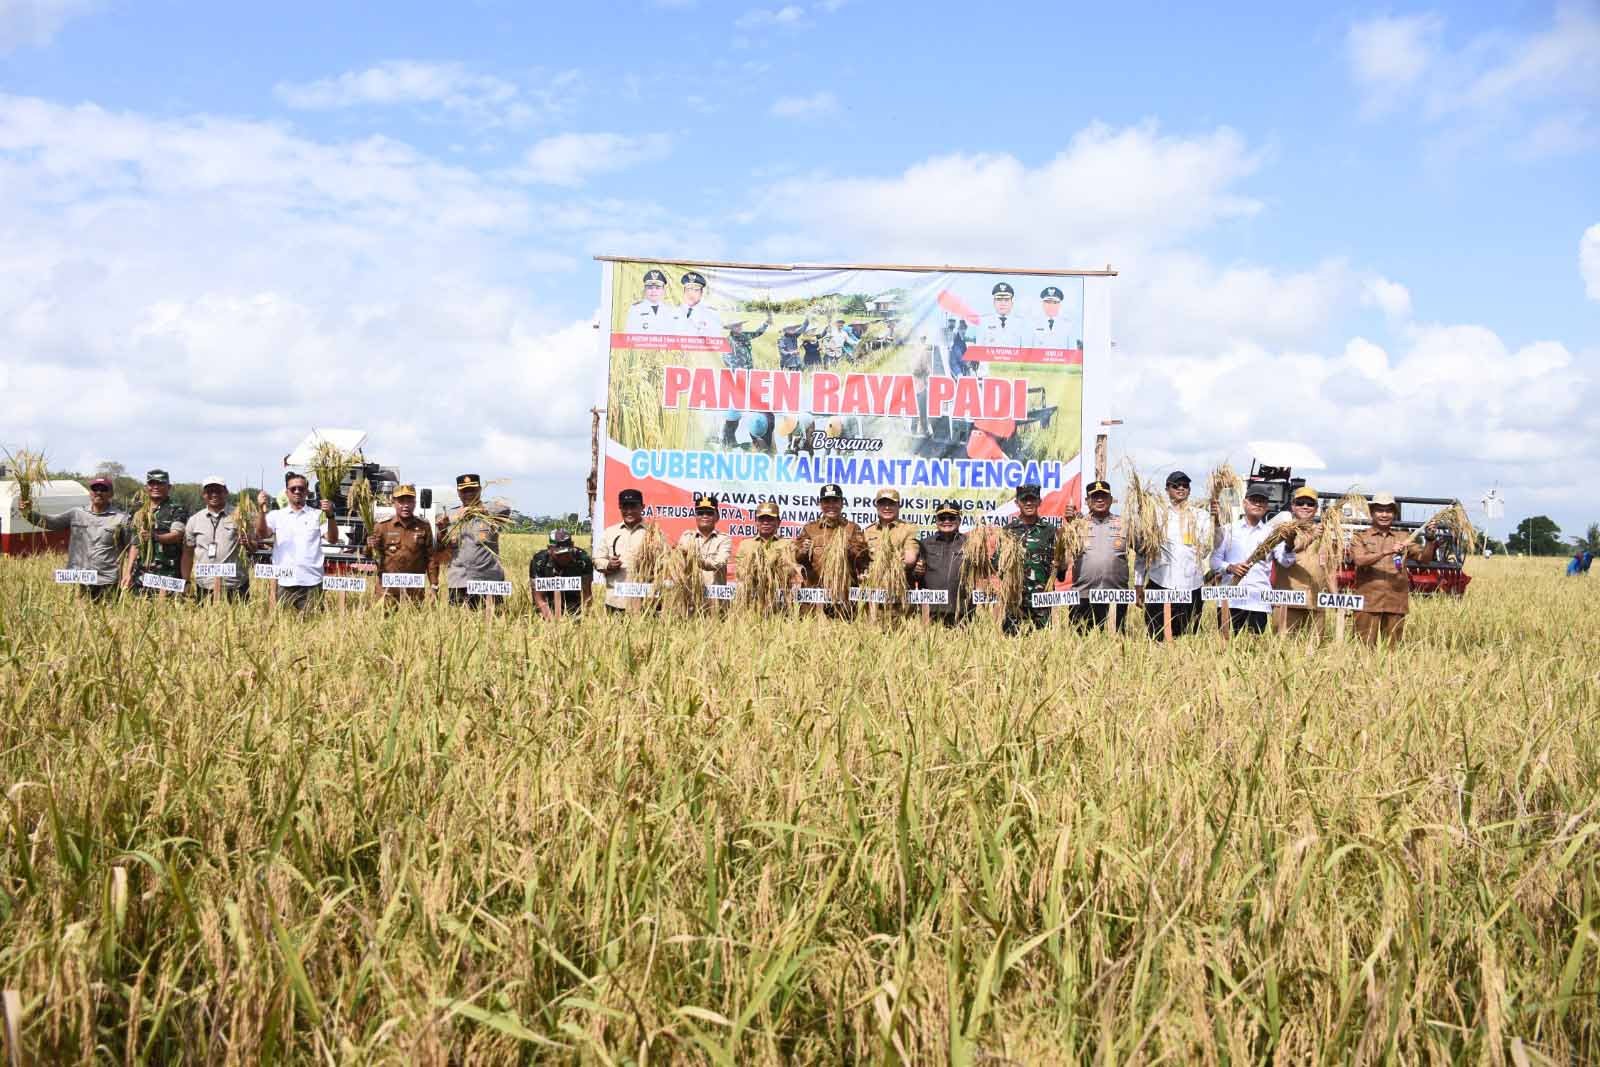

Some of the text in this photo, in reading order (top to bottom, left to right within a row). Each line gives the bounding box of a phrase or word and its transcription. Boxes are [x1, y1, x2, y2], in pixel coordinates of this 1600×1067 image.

[664, 367, 1029, 420] PANEN RAYA PADI
[811, 430, 882, 450] Bersama
[631, 450, 1061, 489] GUBERNUR KALIMANTAN TENGAH
[710, 492, 788, 506] KAWASAN
[792, 495, 849, 508] SENA
[853, 497, 928, 510] PRUKSI
[656, 506, 696, 518] TERUSA
[717, 508, 746, 521] RYA,
[798, 511, 847, 522] MAKR
[902, 513, 937, 525] MULYA
[961, 515, 1009, 527] AMATAN
[730, 524, 792, 537] KABUEN
[275, 567, 293, 577] LAHAN
[536, 578, 580, 590] DANREM 102
[797, 590, 818, 601] BUPATI
[1033, 591, 1079, 606] DANDIM 1011
[1091, 590, 1135, 602] KAPOLRES
[1168, 591, 1191, 602] KAPUAS
[1203, 587, 1219, 599] KETUA
[1260, 591, 1291, 603] KADISTAN
[1319, 594, 1362, 608] CAMAT
